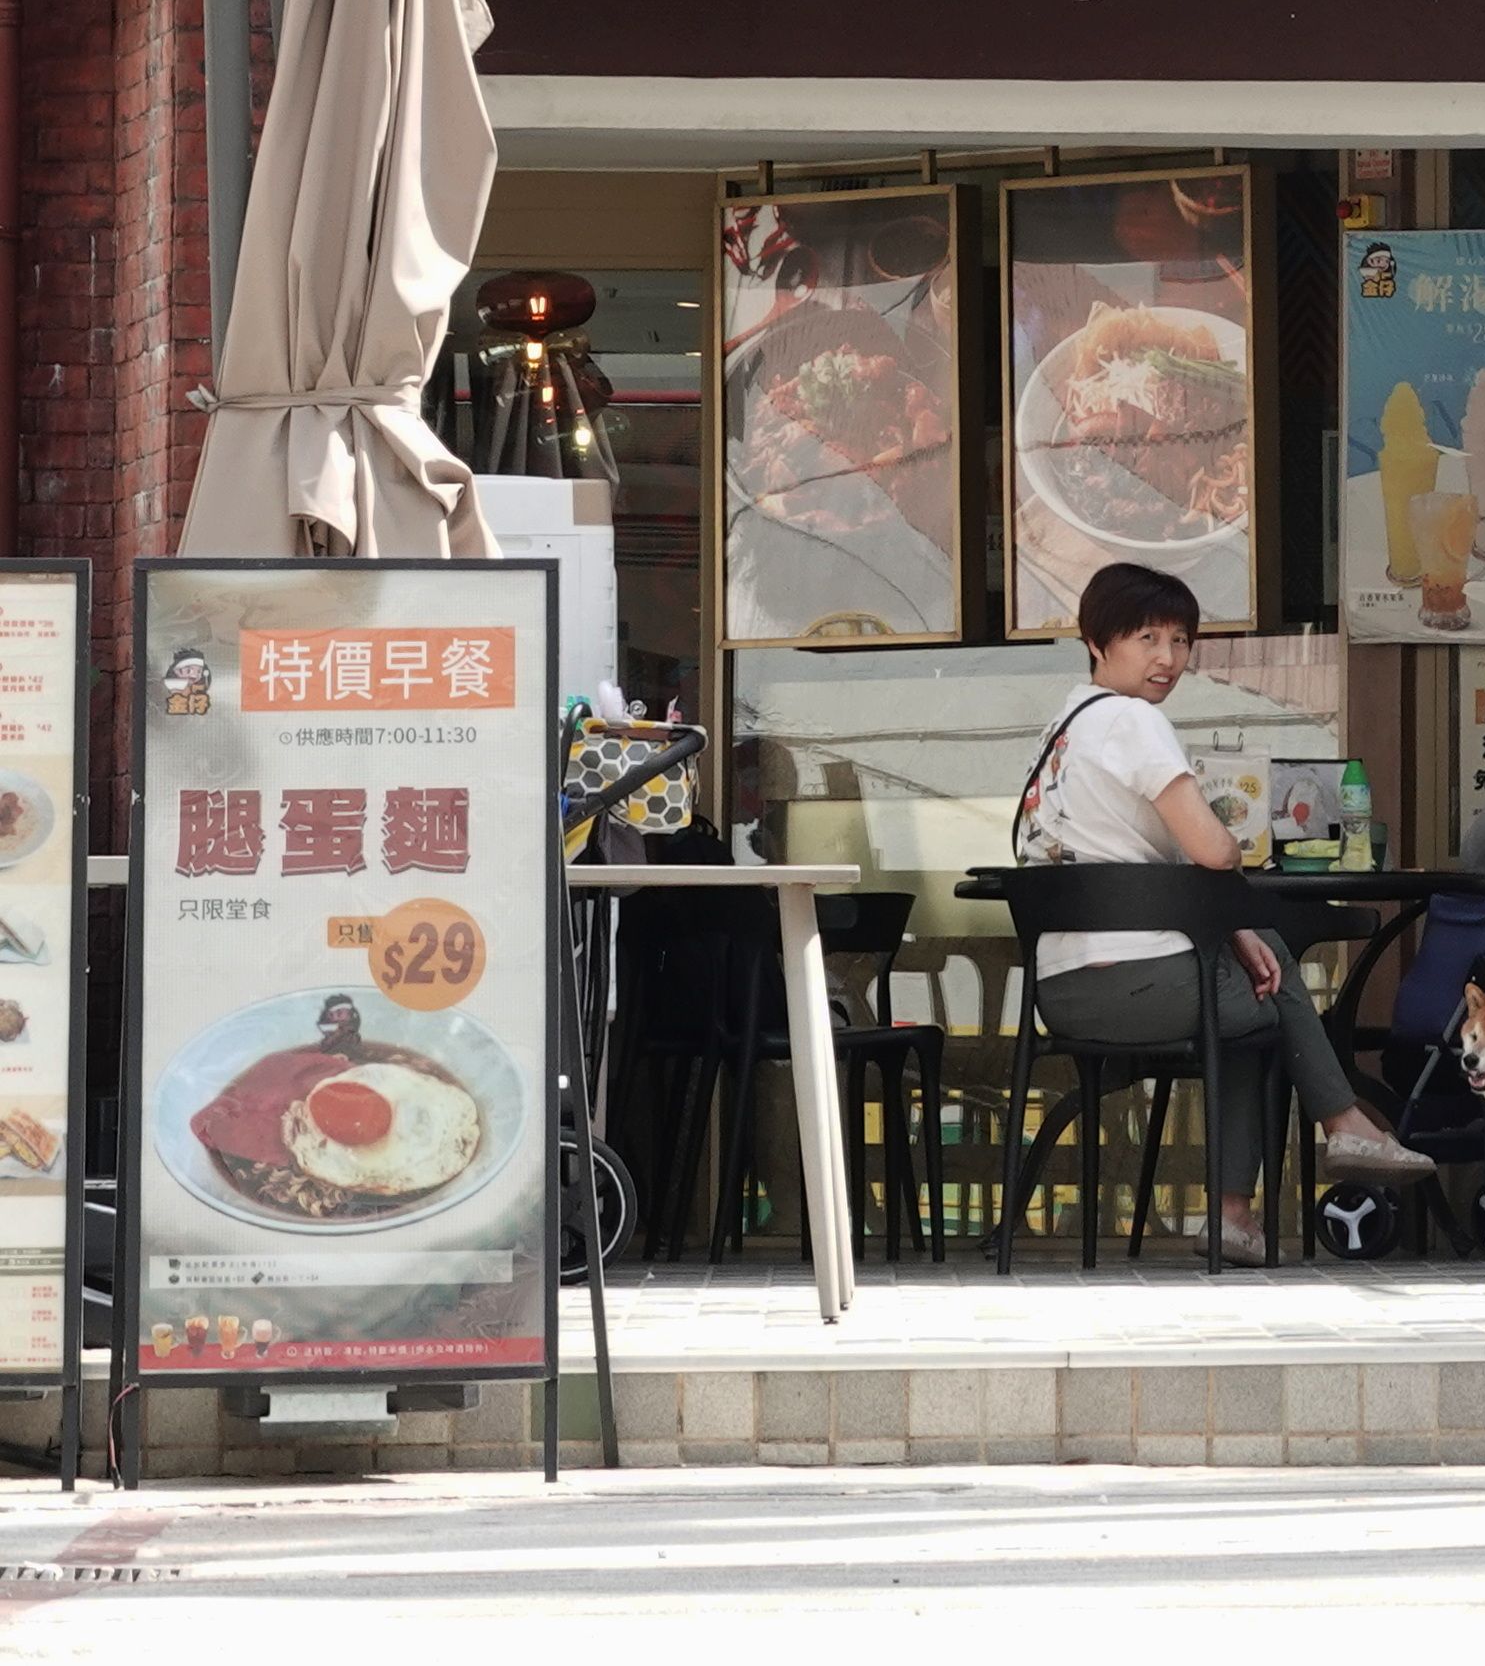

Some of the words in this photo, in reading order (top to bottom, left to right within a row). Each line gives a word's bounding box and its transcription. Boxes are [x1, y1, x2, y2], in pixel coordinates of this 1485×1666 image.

[259, 638, 495, 702] 特價早餐
[166, 692, 212, 715] 金仔
[175, 787, 470, 877] 腿蛋麵
[178, 898, 272, 921] 只限堂食
[338, 922, 374, 944] 只售
[382, 921, 476, 990] $29
